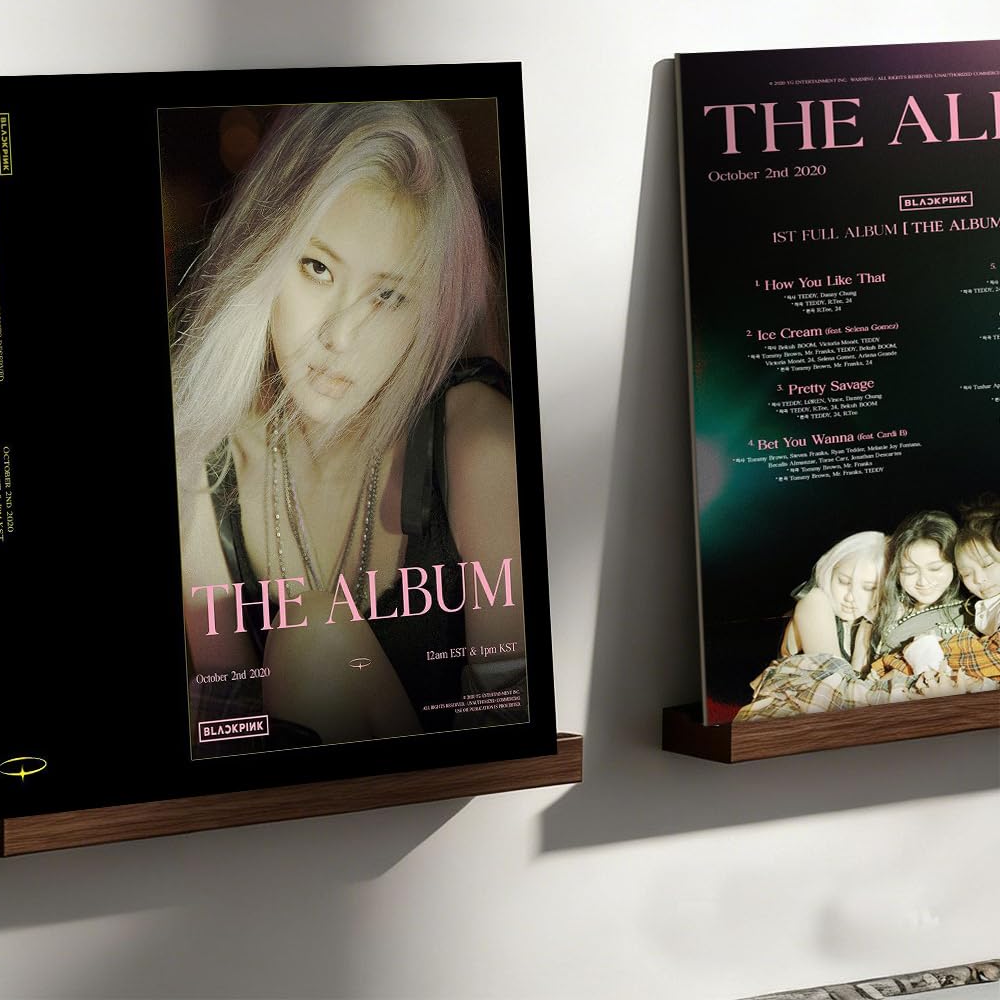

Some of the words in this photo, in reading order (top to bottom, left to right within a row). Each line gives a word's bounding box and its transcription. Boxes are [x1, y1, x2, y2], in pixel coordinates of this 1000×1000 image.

[703, 98, 864, 155] THE
[708, 169, 760, 182] October
[765, 166, 789, 179] 2nd
[794, 164, 827, 178] 2020
[904, 195, 968, 208] BLACKPINK
[773, 230, 797, 243] 1ST
[802, 228, 839, 241] FULL
[845, 223, 897, 239] ALBUM
[911, 220, 944, 234] THE
[949, 217, 1000, 231] ALBUM
[764, 279, 794, 290] How
[798, 277, 823, 288] You
[826, 275, 853, 286] Like
[856, 273, 886, 284] That
[757, 330, 777, 341] Ice
[780, 328, 823, 339] Cream
[845, 325, 869, 333] Selena
[870, 322, 899, 331] Gomez)
[788, 383, 826, 396] Pretty
[830, 380, 875, 392] Savage
[758, 439, 779, 451] Bet
[783, 436, 807, 448] You
[811, 433, 855, 445] Wanna
[876, 430, 897, 439] Cardi
[3, 446, 11, 488] OCTOBER
[5, 491, 13, 508] 2ND
[6, 511, 14, 533] 2020
[191, 577, 308, 636] THE
[325, 558, 515, 624] ALBUM
[426, 650, 448, 661] 12am
[450, 648, 466, 658] EST
[470, 647, 477, 656] &
[480, 645, 497, 658] 1pm
[499, 642, 517, 653] KST
[196, 672, 228, 684] October
[231, 670, 247, 681] 2nd
[250, 667, 270, 679] 2020
[203, 721, 264, 737] BLACKPINK
